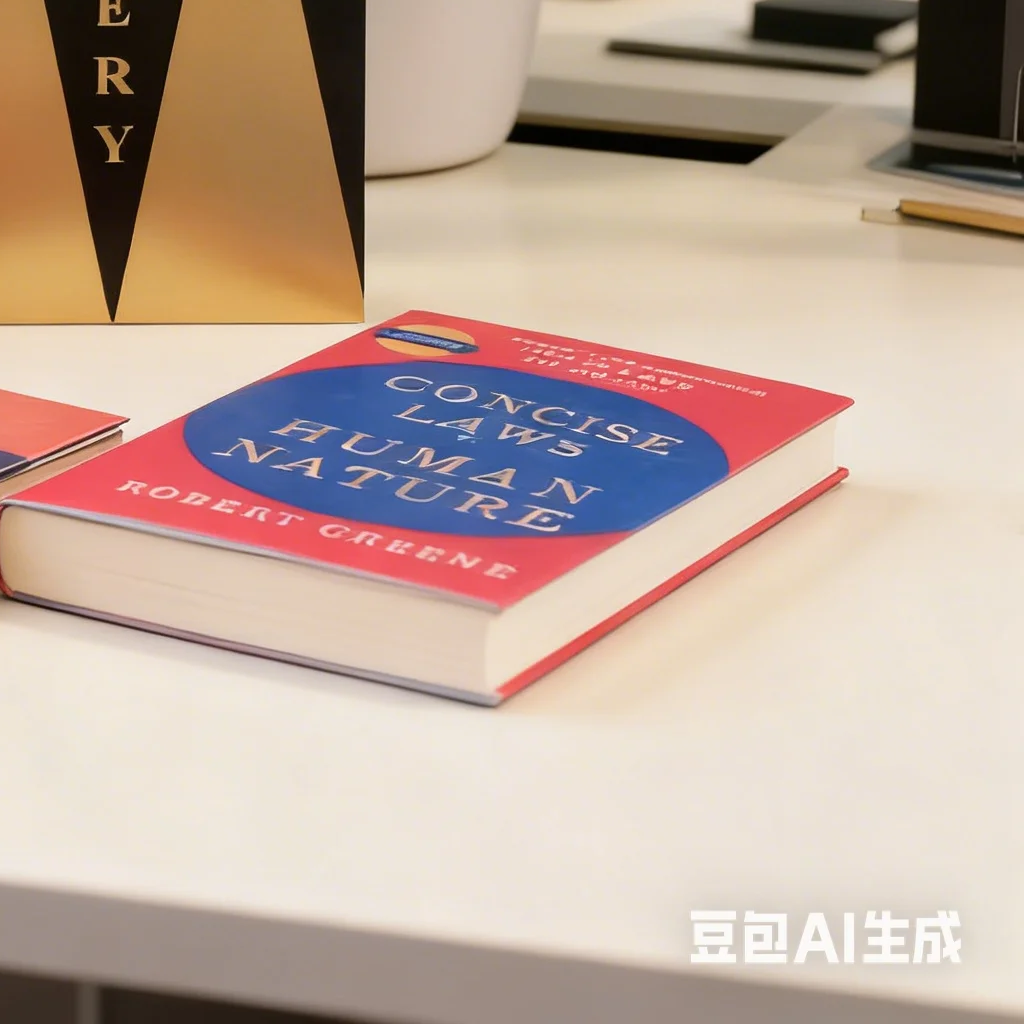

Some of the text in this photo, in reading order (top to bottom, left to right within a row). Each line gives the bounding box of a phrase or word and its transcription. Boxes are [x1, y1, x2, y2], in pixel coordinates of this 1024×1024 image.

[383, 375, 684, 456] CONCISE
[211, 437, 576, 533] NATURE
[269, 418, 604, 505] HUMAN
[115, 479, 519, 581] ROBERT GREENE
